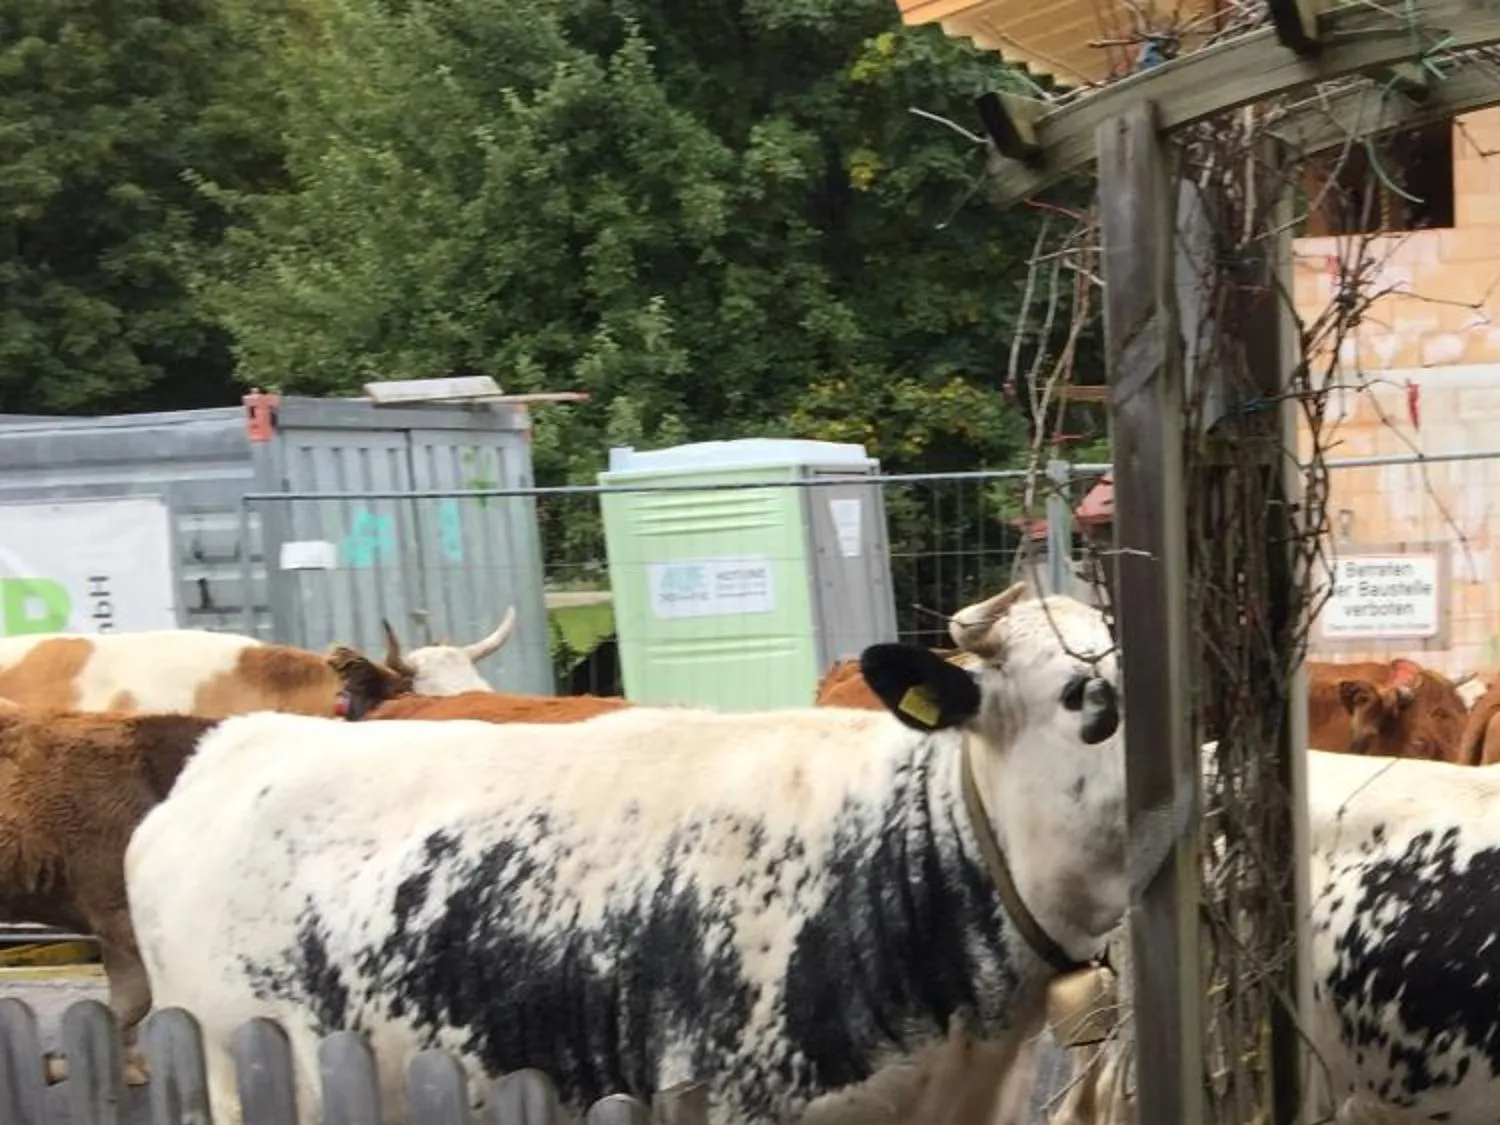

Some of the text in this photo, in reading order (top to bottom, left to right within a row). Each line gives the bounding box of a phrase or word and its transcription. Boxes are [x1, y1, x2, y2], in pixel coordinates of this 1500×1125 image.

[1334, 580, 1433, 597] er Baustelle
[1343, 602, 1414, 617] verboten
